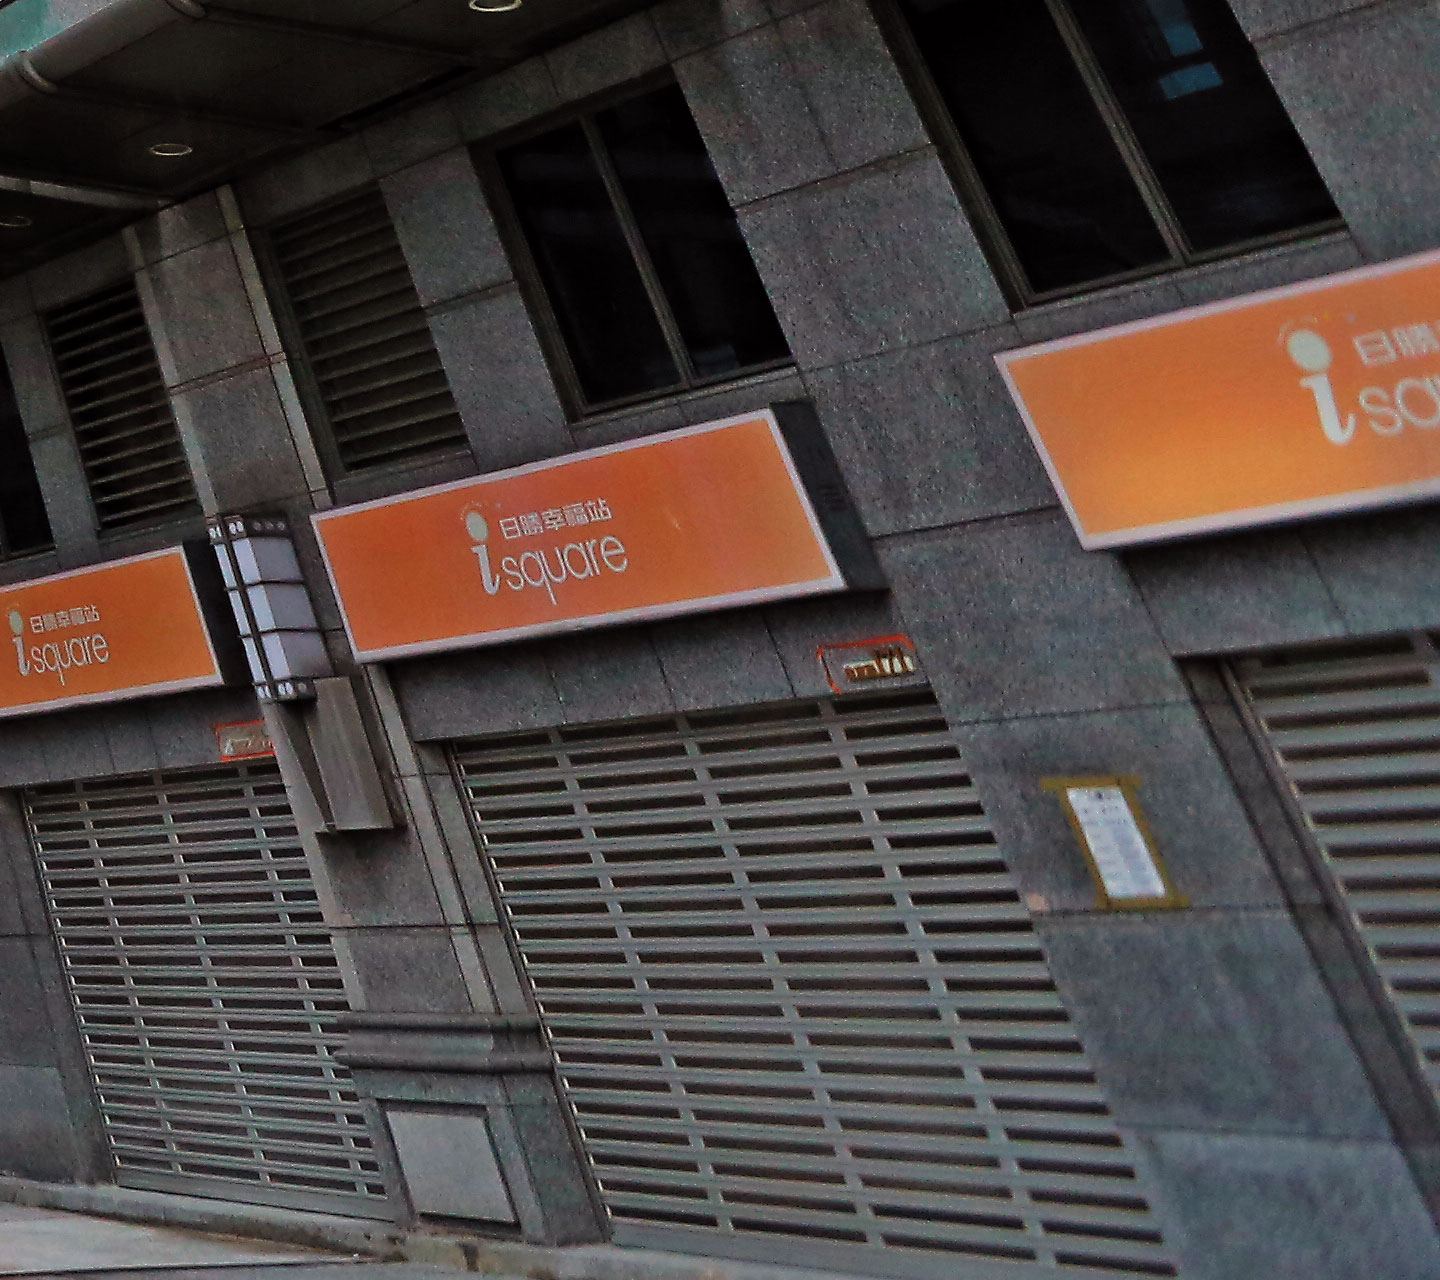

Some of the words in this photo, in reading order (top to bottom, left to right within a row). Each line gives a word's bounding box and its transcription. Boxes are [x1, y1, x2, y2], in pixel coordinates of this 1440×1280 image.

[498, 497, 614, 540] 日勝幸福站
